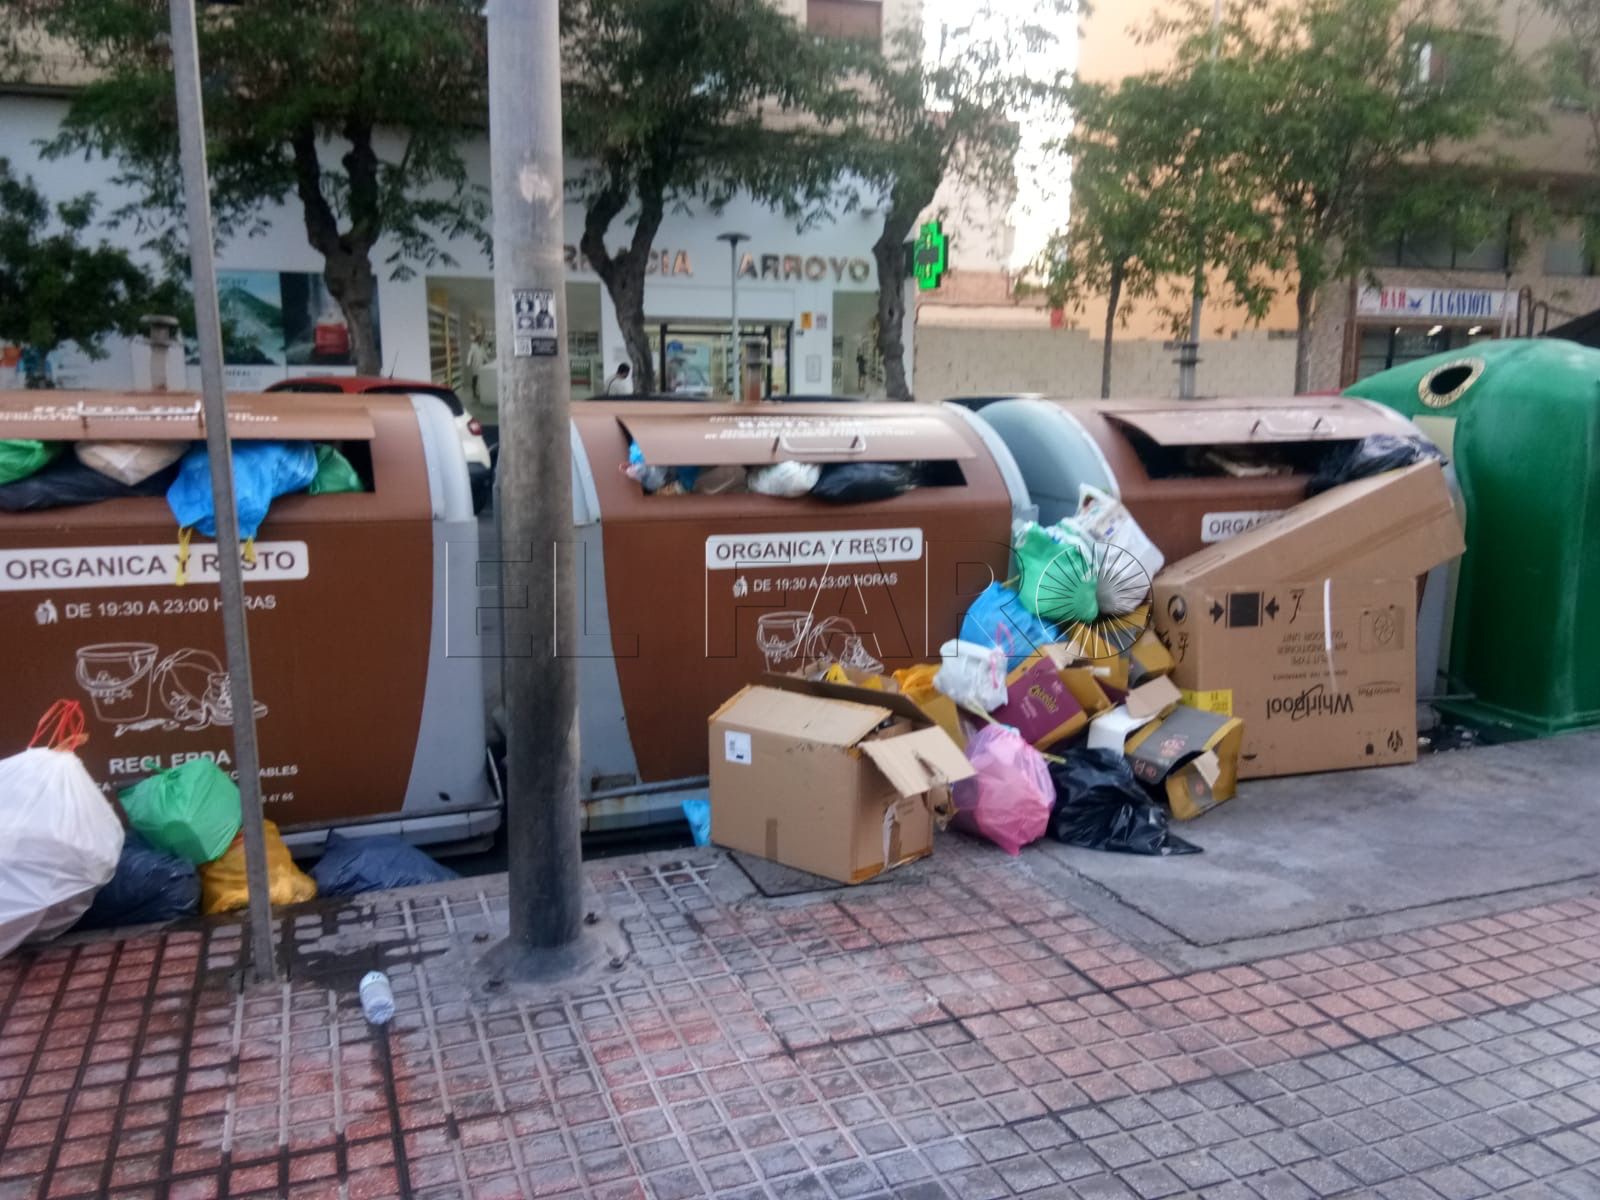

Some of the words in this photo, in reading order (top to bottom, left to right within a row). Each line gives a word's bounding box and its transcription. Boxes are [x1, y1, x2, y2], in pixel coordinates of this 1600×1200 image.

[737, 252, 871, 283] ARROYO
[1380, 288, 1406, 308] BAR
[1209, 517, 1261, 535] ORGA
[716, 540, 826, 561] ORGANICA
[832, 540, 843, 556] Y
[850, 536, 914, 555] RESTO
[5, 555, 167, 580] ORGANICA
[202, 551, 296, 573] RSTO
[753, 579, 771, 592] DE
[776, 577, 807, 591] 19:30
[809, 578, 818, 590] A
[820, 576, 851, 589] 23:00
[854, 573, 898, 586] HORAS
[65, 603, 92, 618] DE
[98, 601, 143, 618] 19:30
[147, 600, 160, 614] A
[163, 598, 209, 614] 23:00
[214, 595, 277, 613] HRAS
[1266, 684, 1354, 720] Whirlpool
